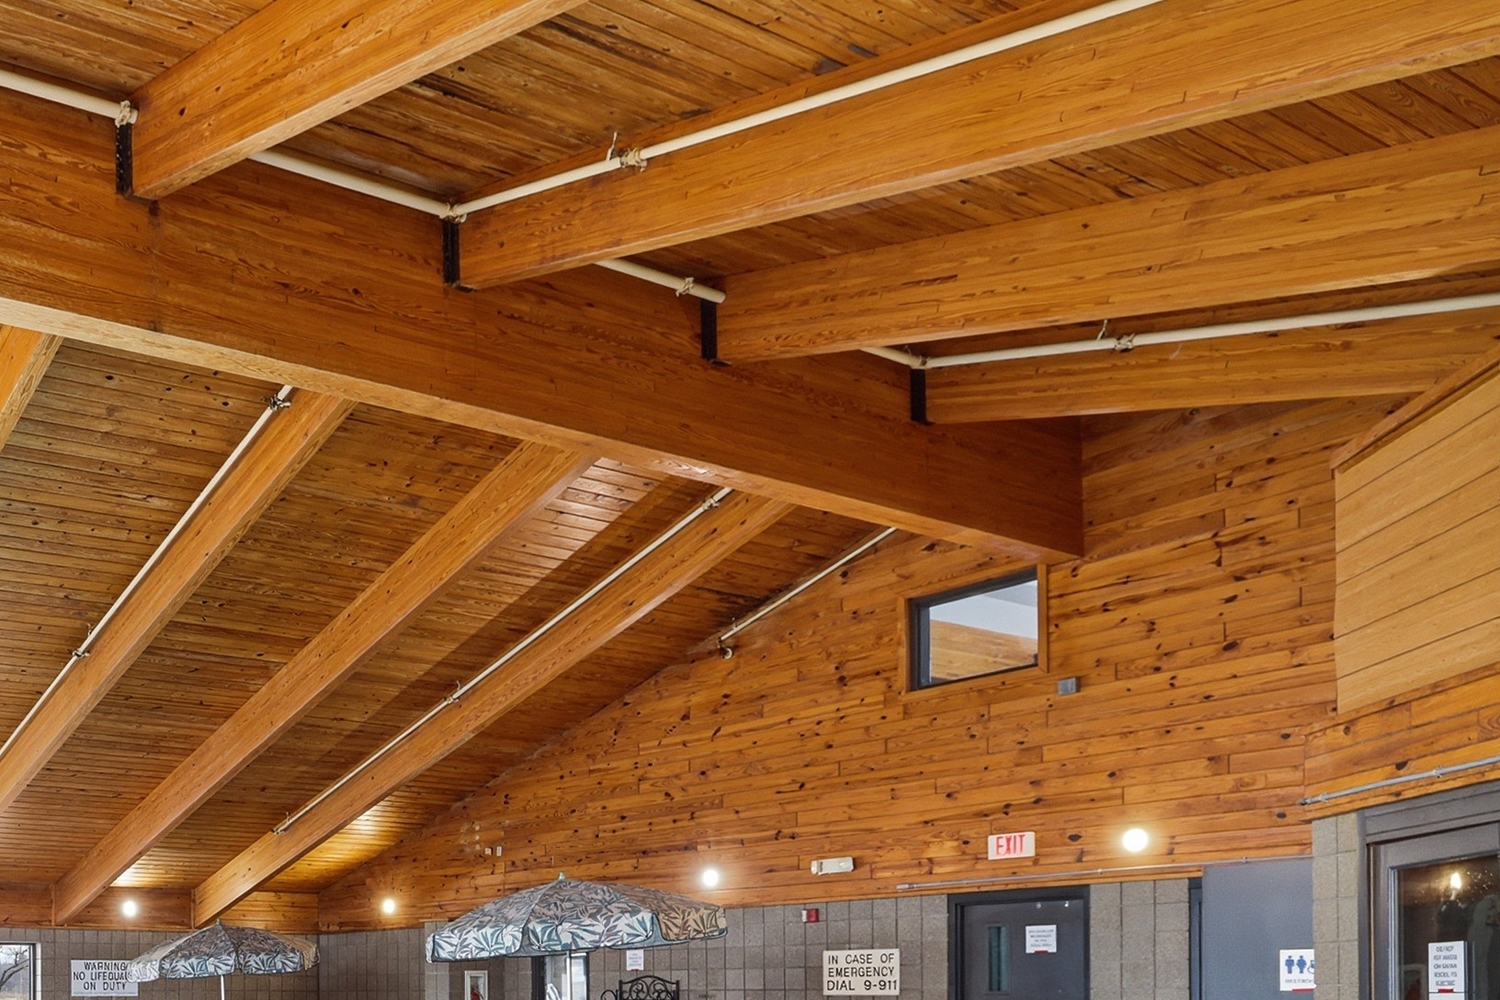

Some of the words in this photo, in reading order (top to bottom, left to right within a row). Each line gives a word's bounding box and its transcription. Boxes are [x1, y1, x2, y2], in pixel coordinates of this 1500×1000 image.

[996, 834, 1025, 855] EXIT
[828, 955, 838, 965] IN
[845, 954, 873, 964] CASE
[880, 953, 895, 963] OF
[73, 971, 86, 980] NO
[828, 966, 895, 978] EMERGENCY
[83, 982, 96, 990] ON
[102, 982, 127, 991] DUTY
[827, 980, 855, 991] DIAL
[864, 980, 897, 991] 9-911
